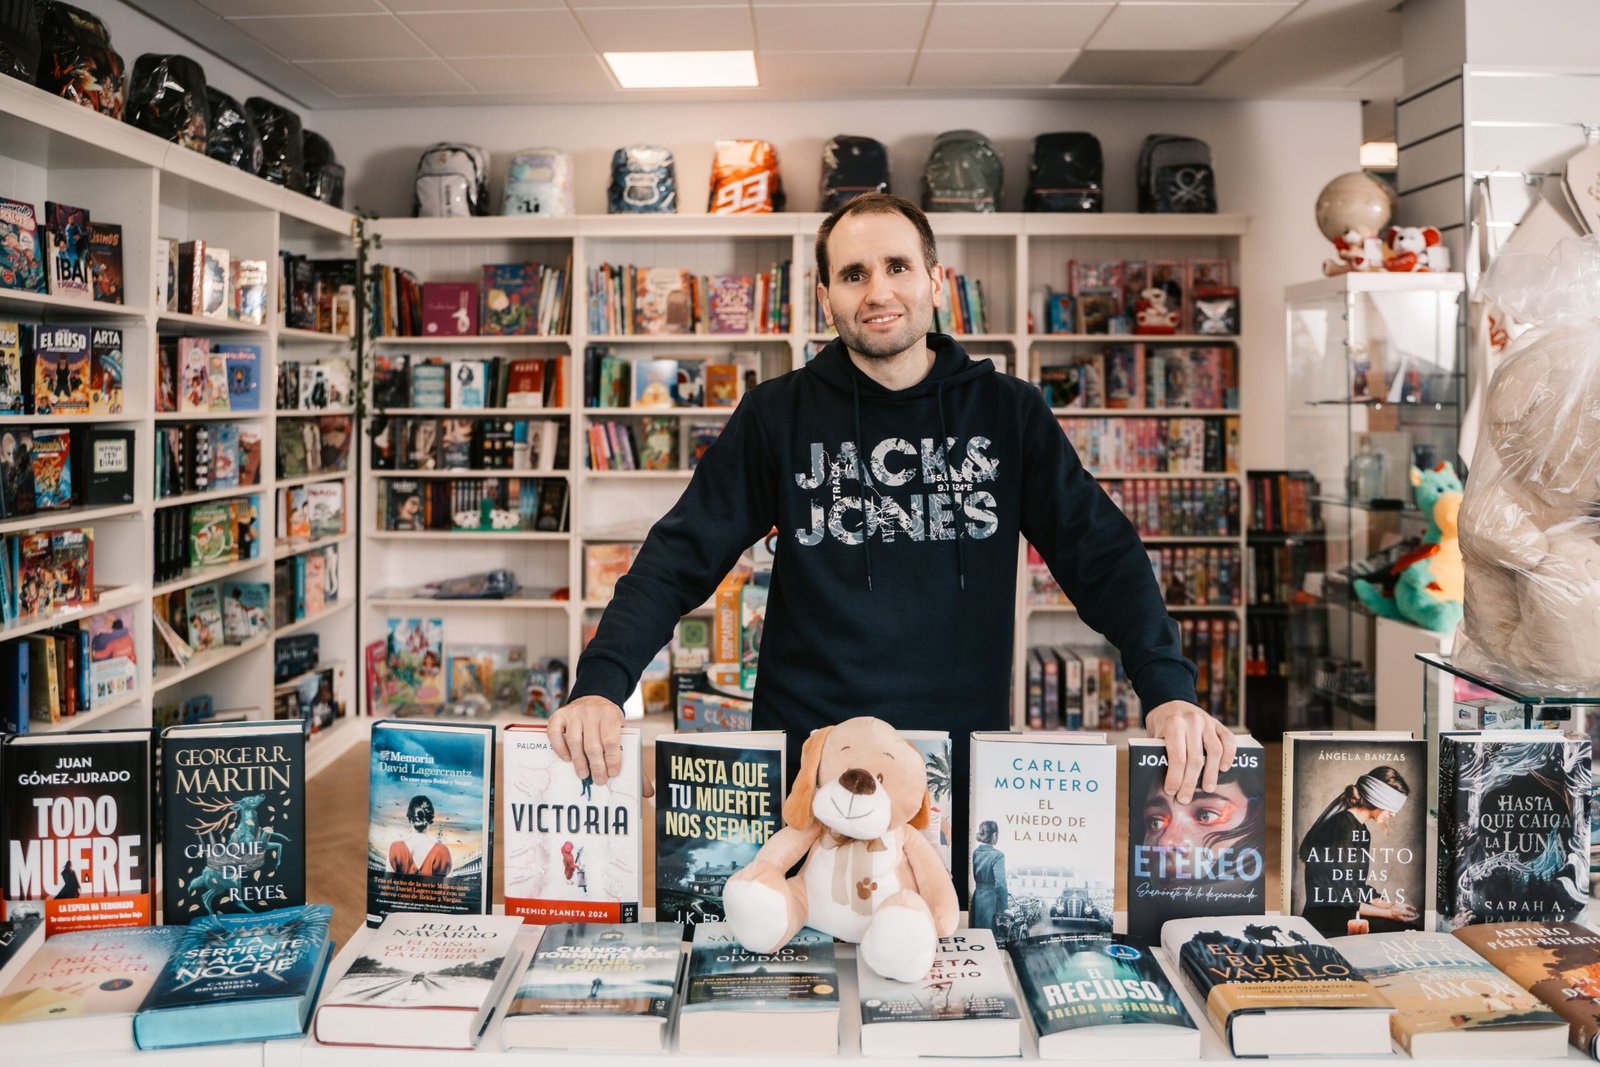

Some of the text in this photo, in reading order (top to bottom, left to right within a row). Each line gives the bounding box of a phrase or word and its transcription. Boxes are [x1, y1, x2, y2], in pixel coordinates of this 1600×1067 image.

[56, 255, 88, 284] IBAI
[40, 331, 86, 350] EL RUSO
[93, 330, 120, 345] ARTA
[831, 462, 841, 501] TRACK
[795, 491, 998, 545] JONES
[56, 757, 92, 769] JUAN
[175, 746, 291, 767] GEORGE R.R.
[390, 751, 434, 764] Memoria
[1138, 754, 1168, 767] JOA
[1318, 751, 1406, 762] ÁNGELA BANZAS
[380, 762, 472, 778] David Lagercrantz
[670, 756, 769, 788] HASTA QUE
[1012, 758, 1082, 773] CARLA
[18, 770, 131, 785] GÓMEZ-JURADO
[175, 765, 291, 794] MARTIN
[994, 777, 1099, 792] MONTERO
[668, 784, 771, 816] TU MUERTE
[1038, 799, 1055, 811] EL
[1497, 794, 1554, 812] HASTA
[33, 795, 118, 838] TODO
[511, 803, 629, 835] VICTORIA
[1005, 812, 1087, 828] VIÑEDO DE
[1480, 813, 1573, 834] QUE CAIGA
[665, 811, 701, 839] NOS
[1014, 831, 1079, 844] LA LUNA
[1351, 830, 1370, 843] EL
[1485, 830, 1567, 853] LA LUNA
[184, 841, 264, 860] CHOQUE
[1306, 846, 1414, 865] ALIENTO
[10, 835, 142, 899] MUERE
[1133, 845, 1263, 882] ETEREO
[223, 865, 247, 879] DE
[1332, 869, 1389, 882] DE LAS
[229, 885, 285, 902] REYES
[1313, 886, 1407, 904] LLAMAS
[58, 904, 67, 913] LA
[67, 903, 90, 912] ESPERA
[100, 900, 134, 910] TERMINADO
[516, 906, 609, 919] PREMIO PLANETA 2024
[1484, 900, 1566, 913] SARAH A.
[392, 929, 498, 939] NAVARRO
[417, 923, 479, 932] JULIA
[1495, 926, 1571, 938] ARTURO
[184, 938, 304, 959] SERPIENTE
[234, 936, 264, 947] LA
[1206, 943, 1243, 955] EL
[537, 951, 629, 960] TORMENTA
[556, 945, 632, 954] CUANDO
[733, 948, 749, 956] EL
[208, 951, 272, 966] ALAS
[1226, 953, 1310, 967] BUEN
[1385, 951, 1484, 969] KELLEN
[175, 958, 297, 980] NOCHE
[1087, 968, 1104, 979] EL
[1210, 964, 1350, 979] VASALLO
[194, 983, 261, 993] BROADBENT
[207, 979, 253, 987] CARISSA
[1042, 979, 1164, 1006] RECLUSO
[1047, 1004, 1097, 1020] FREIDA
